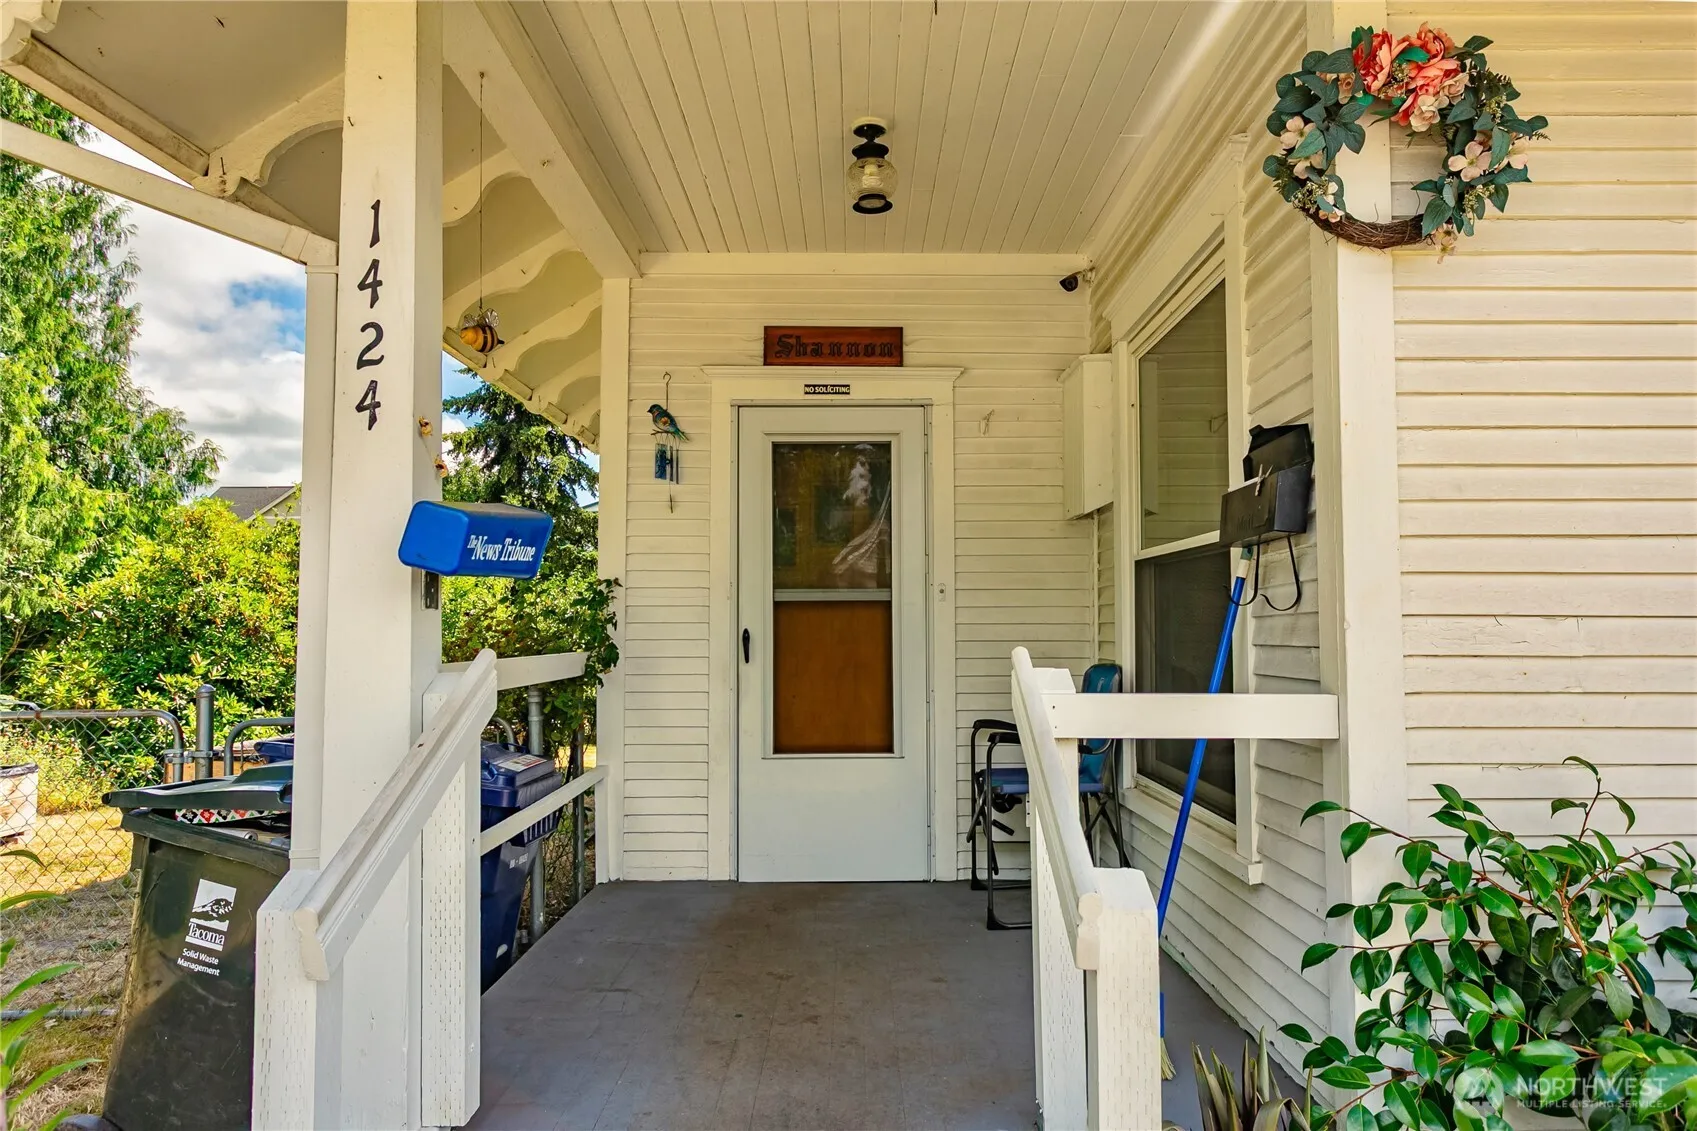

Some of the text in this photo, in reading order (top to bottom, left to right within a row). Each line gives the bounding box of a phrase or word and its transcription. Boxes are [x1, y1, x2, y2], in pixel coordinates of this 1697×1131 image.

[355, 199, 385, 431] 1424
[774, 334, 894, 358] Shannon
[471, 535, 503, 561] News
[500, 537, 536, 562] Tribune
[188, 922, 225, 945] Tacoma
[177, 957, 220, 976] Management
[182, 948, 219, 965] Solid Waste
